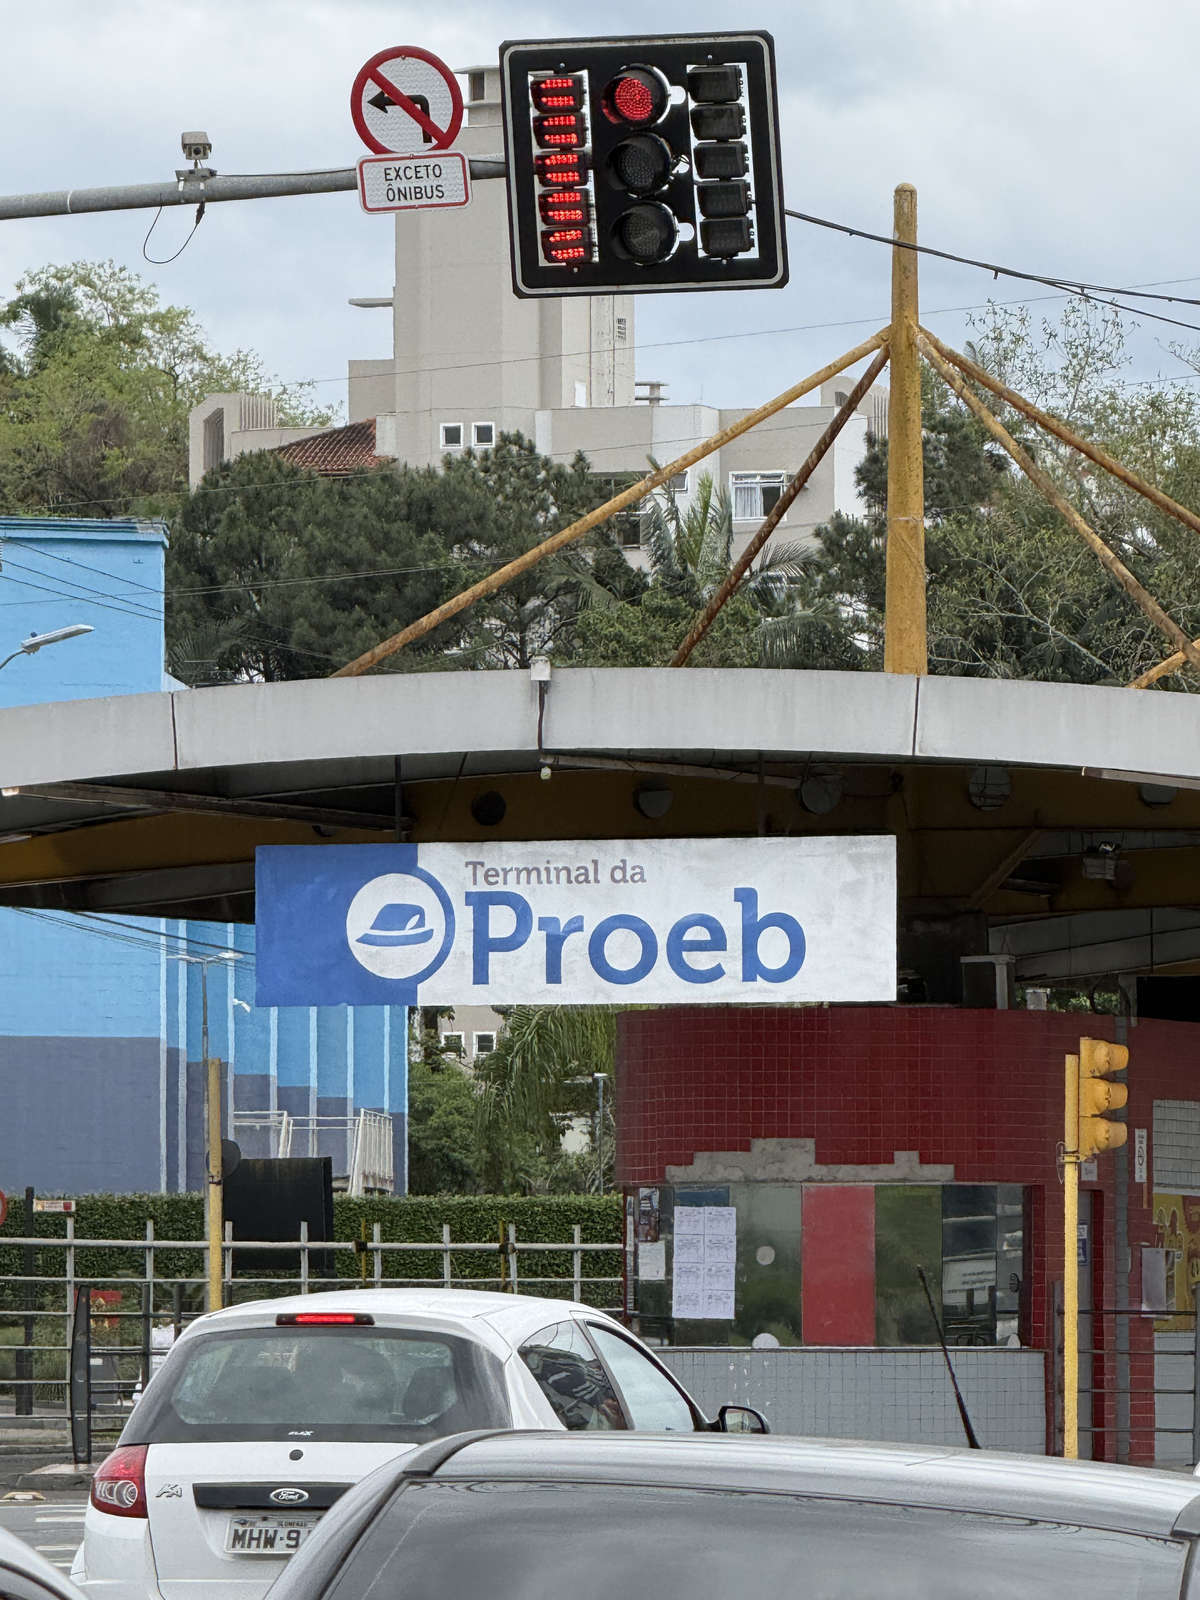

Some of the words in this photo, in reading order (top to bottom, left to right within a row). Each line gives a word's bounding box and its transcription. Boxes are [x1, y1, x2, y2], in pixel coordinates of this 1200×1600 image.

[384, 164, 442, 181] EXCETO
[386, 183, 445, 202] ÔNIBUS
[465, 859, 600, 886] Terminal
[610, 859, 647, 884] da
[464, 887, 806, 985] Proeb
[231, 1528, 309, 1549] MHW-9
